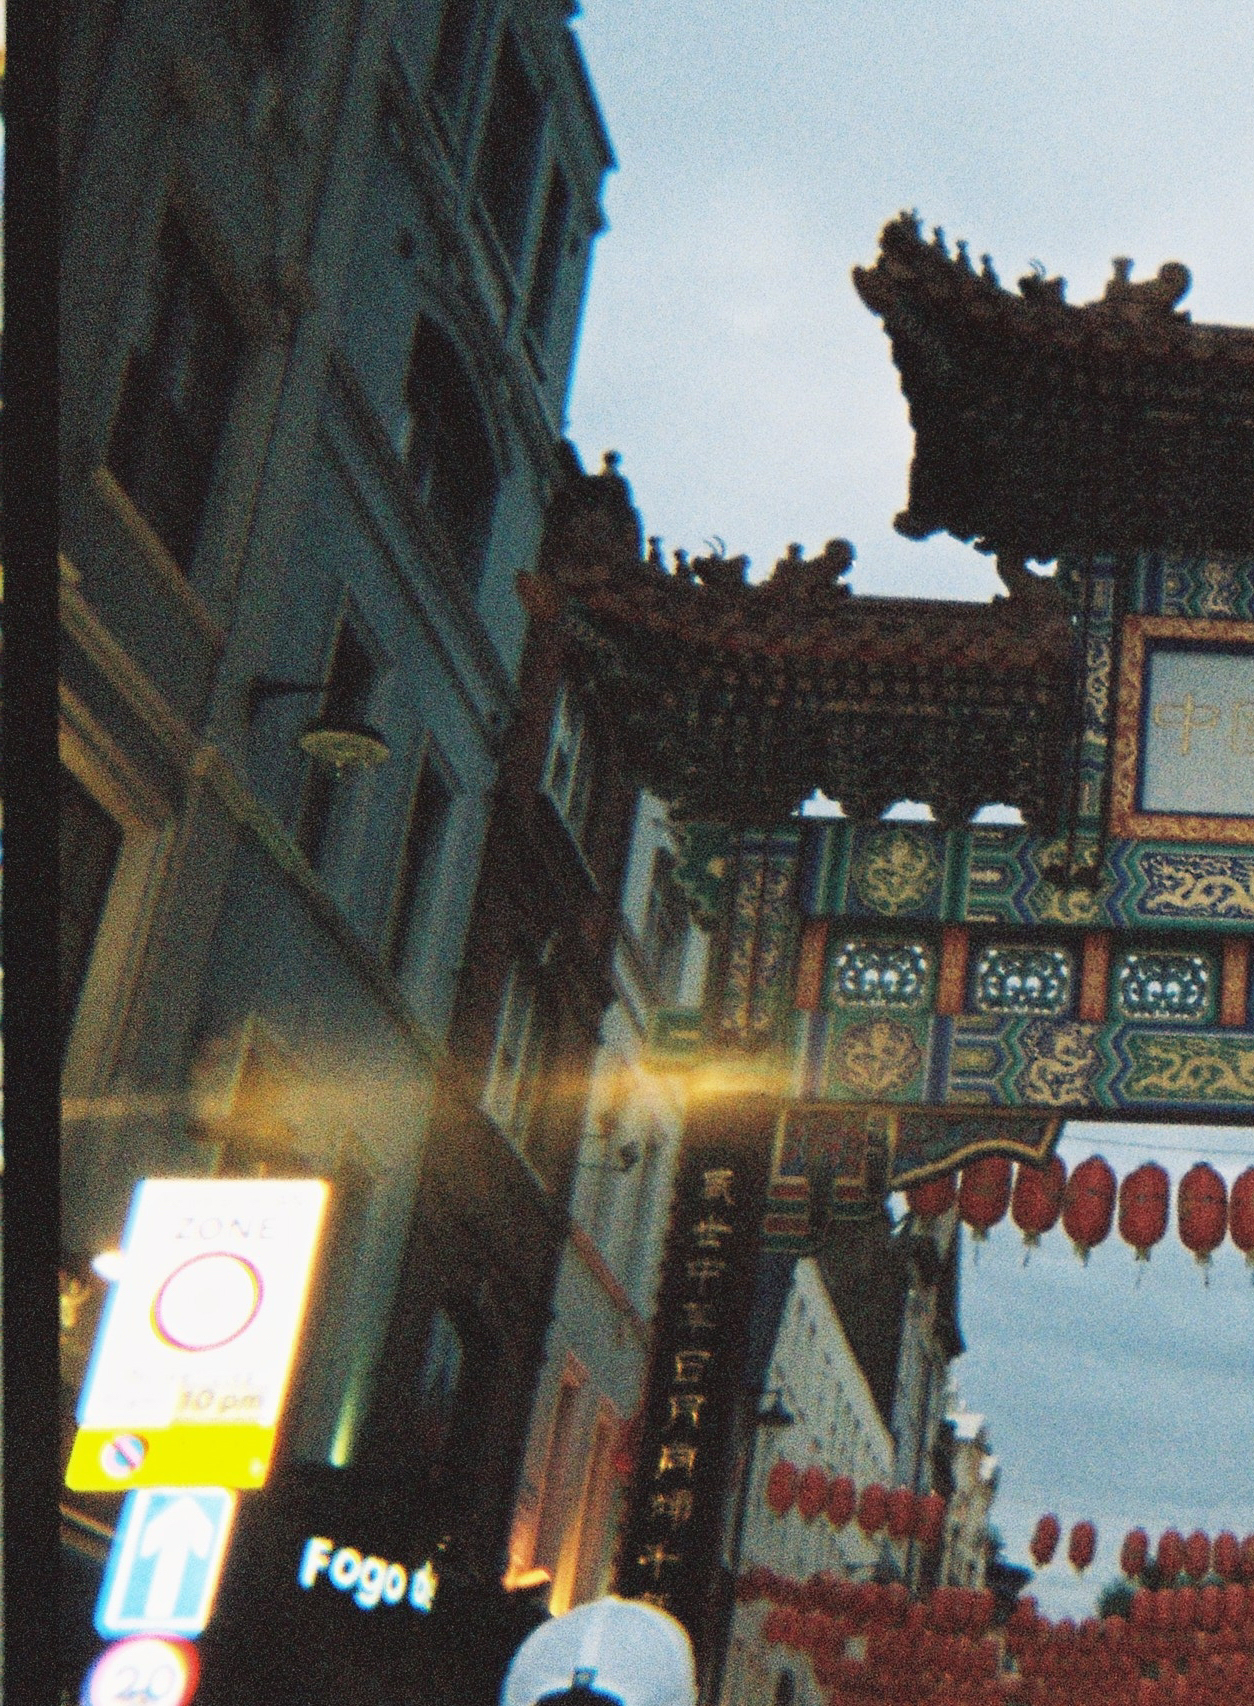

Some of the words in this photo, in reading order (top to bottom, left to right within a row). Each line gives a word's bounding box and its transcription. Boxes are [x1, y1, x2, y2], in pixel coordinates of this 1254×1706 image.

[175, 1217, 276, 1241] ZONE
[298, 1535, 408, 1612] Fogo
[114, 1664, 177, 1700] 20
